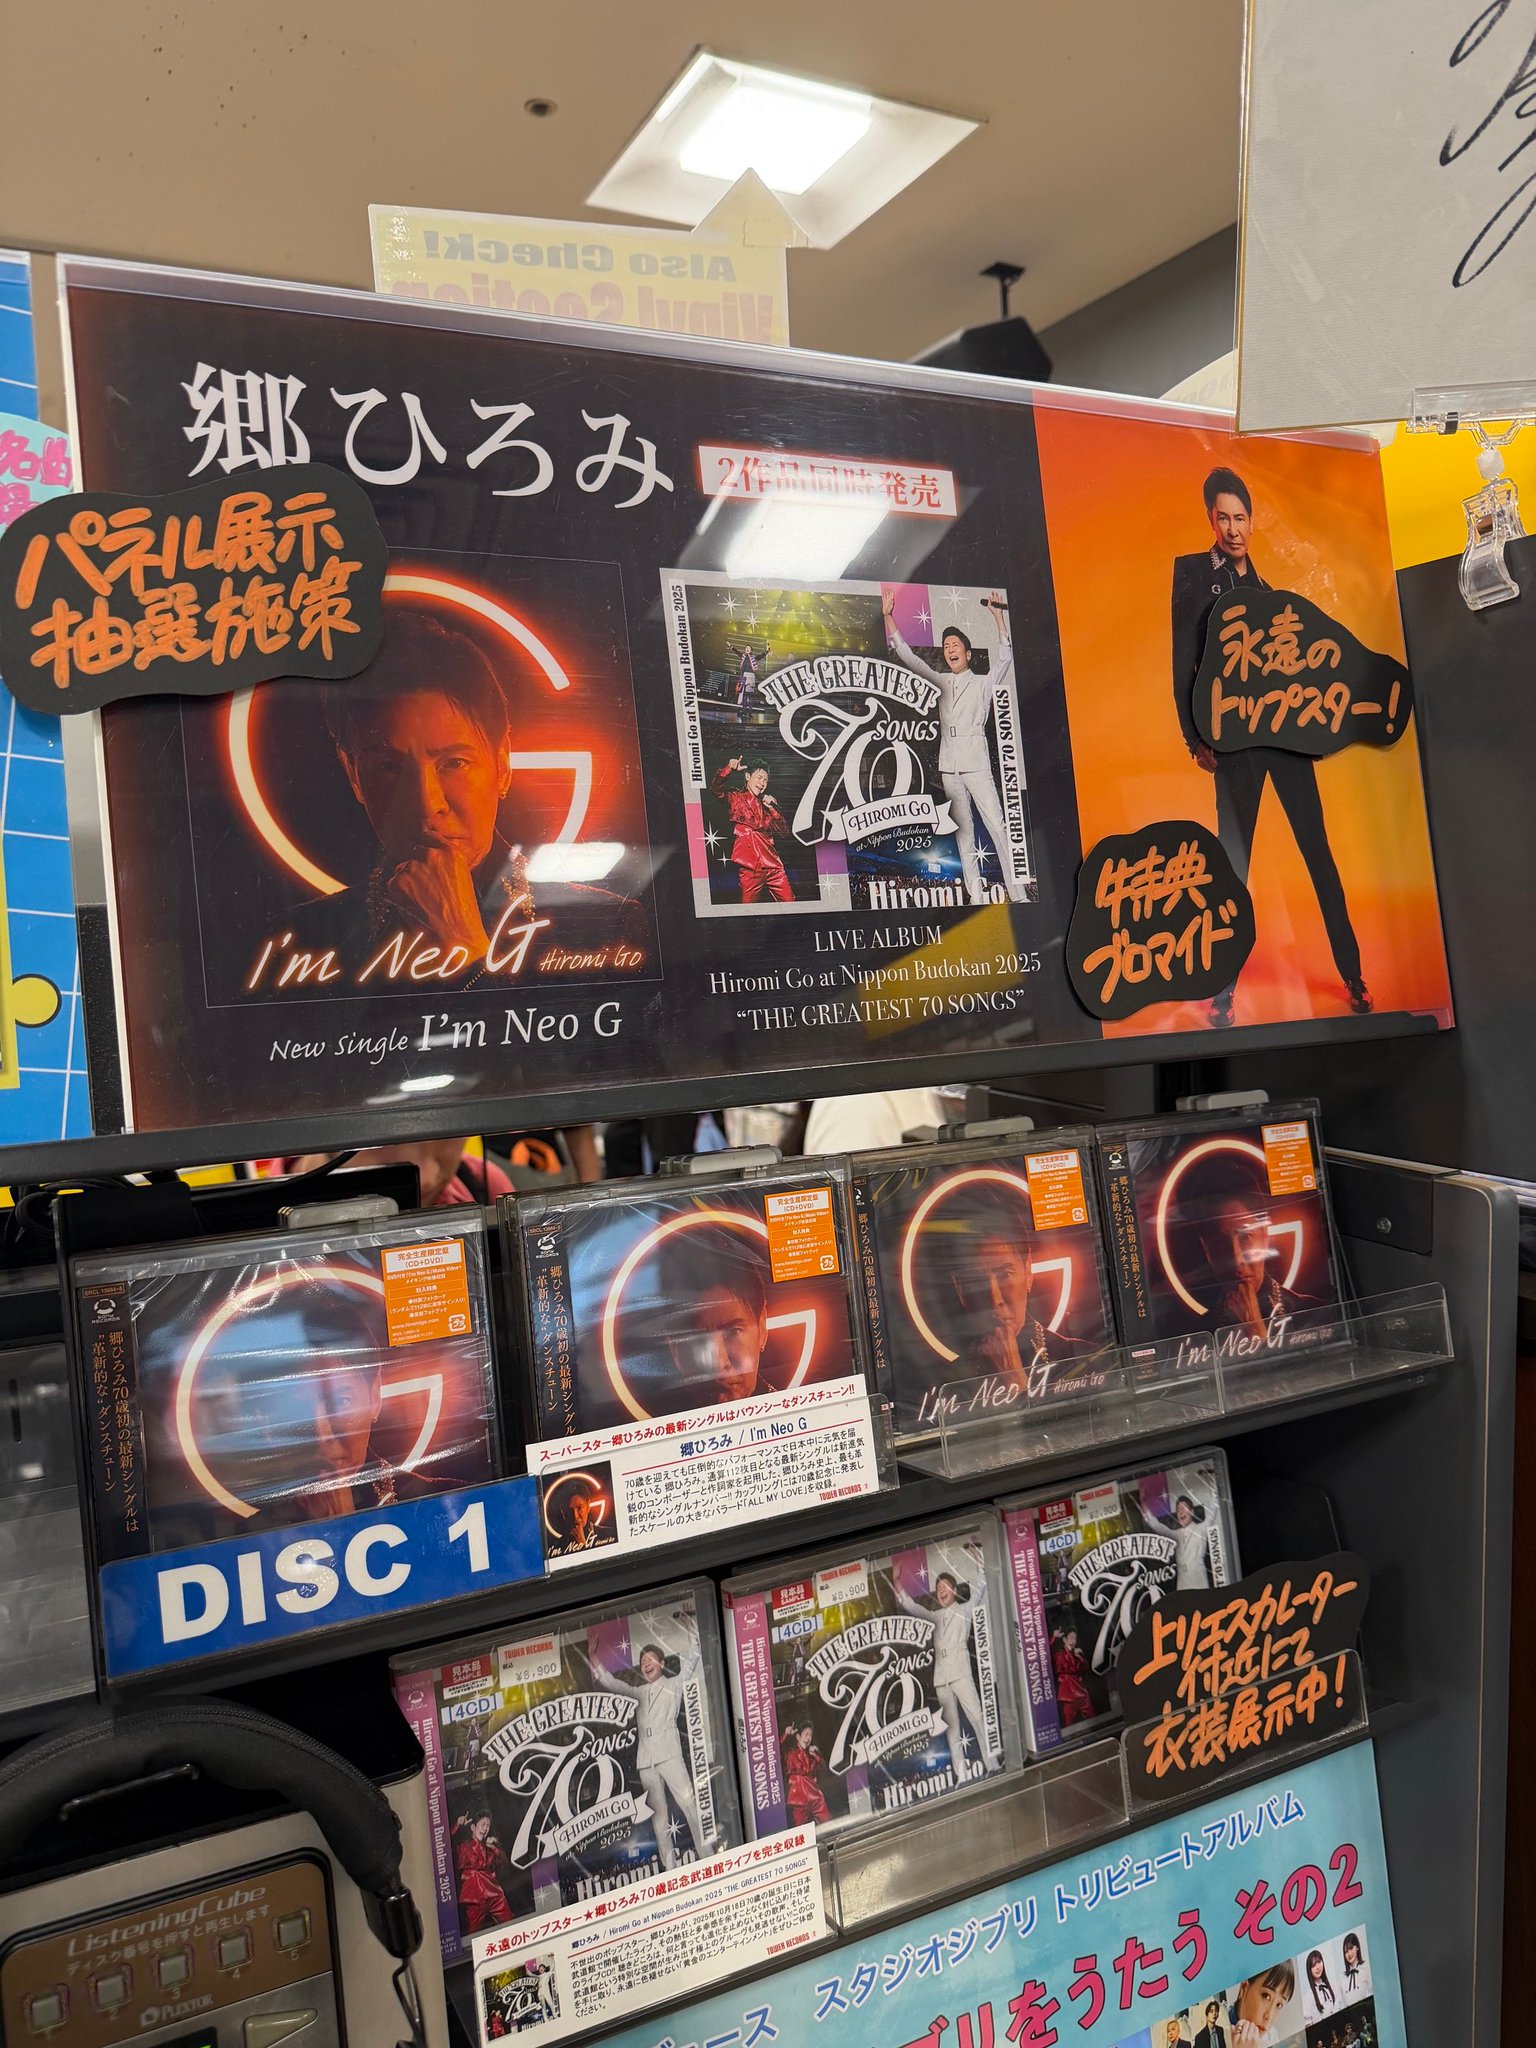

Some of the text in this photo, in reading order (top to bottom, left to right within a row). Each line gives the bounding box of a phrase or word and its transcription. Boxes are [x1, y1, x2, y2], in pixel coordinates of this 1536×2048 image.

[181, 361, 675, 508] 郷ひろみ
[717, 456, 942, 508] 2作品同時発売
[16, 491, 345, 609] パネル展示
[31, 556, 364, 689] 抽選施策
[671, 585, 684, 616] 2025
[676, 618, 692, 671] Budokan
[1220, 603, 1341, 684] 永遠の
[680, 672, 697, 713] Nippon
[760, 656, 941, 716] THE GREATEST
[688, 727, 699, 742] Go
[872, 718, 940, 741] SONGS
[689, 744, 703, 783] Hiromi
[778, 697, 925, 847] 70
[995, 689, 1030, 880] THE GREATEST 70 SONGS
[895, 834, 932, 853] 2025
[868, 877, 964, 910] Hiromi
[1094, 842, 1213, 929] 特典
[360, 931, 470, 984] Neo
[486, 893, 552, 974] G
[539, 948, 609, 972] Hiromi
[613, 947, 643, 969] Go
[813, 925, 943, 952] LIVE ALBUM
[1082, 899, 1235, 1003] ブロマイド
[709, 952, 1042, 995] Hiromi Go at Nippon Budokan 2025
[736, 989, 1026, 1031] “THE GREATEST 70 SONGS”
[269, 1039, 327, 1062] New
[334, 1027, 409, 1066] Single
[501, 1007, 580, 1046] Neo
[594, 1002, 624, 1037] G
[968, 1377, 1020, 1413] Neo
[1027, 1347, 1058, 1398] G
[109, 1331, 139, 1533] 郷ひろみ70歳初の最新シングルは
[680, 1433, 734, 1458] 郷ひろみ
[770, 1419, 794, 1439] Neo
[797, 1416, 808, 1431] G
[626, 1486, 662, 1501] けている
[767, 1492, 779, 1504] MY
[819, 1483, 863, 1502] TOWER RECORDS
[157, 1501, 491, 1644] DISC 1
[832, 1583, 866, 1602] ¥8,900
[504, 1641, 554, 1660] TOWER RECORDS
[808, 1616, 934, 1680] THE GREATEST
[1133, 1570, 1358, 1686] 上りエスカレーター
[452, 1660, 482, 1677] 見本品
[515, 1662, 557, 1682] ¥8,900
[741, 1638, 756, 1670] THE
[755, 1636, 769, 1672] Hiromi
[886, 1648, 935, 1679] SONGS
[1176, 1626, 1315, 1713] 付近にて
[759, 1672, 769, 1687] Go
[485, 1693, 638, 1762] THE GREATEST
[744, 1672, 764, 1743] GREATEST
[762, 1699, 773, 1734] Nippon
[580, 1727, 638, 1761] SONGS
[752, 1744, 765, 1761] 70
[766, 1735, 778, 1780] Budokan
[499, 1725, 625, 1870] 70
[753, 1763, 770, 1812] SONGS
[770, 1780, 782, 1806] 2025
[883, 1764, 954, 1810] Hiromi
[576, 1855, 660, 1901] Hiromi
[1233, 1843, 1364, 1946] その2
[571, 1932, 600, 1951] 郷ひろみ
[608, 1919, 631, 1937] Hiromi
[631, 1917, 642, 1930] Go
[643, 1916, 651, 1926] at
[651, 1905, 675, 1923] Nippon
[675, 1896, 704, 1916] Budokan
[704, 1890, 723, 1905] 2025
[741, 1870, 773, 1890] GREATEST
[774, 1868, 783, 1879] 70
[813, 1788, 1307, 2022] スタジオジブリ トリビュートアルバム
[66, 1903, 271, 1977] ディスク番号を押すと再生します
[766, 1931, 811, 1956] TOWER RECORDS
[108, 1949, 299, 2022] 2 3 4 5
[575, 2003, 607, 2019] ください。
